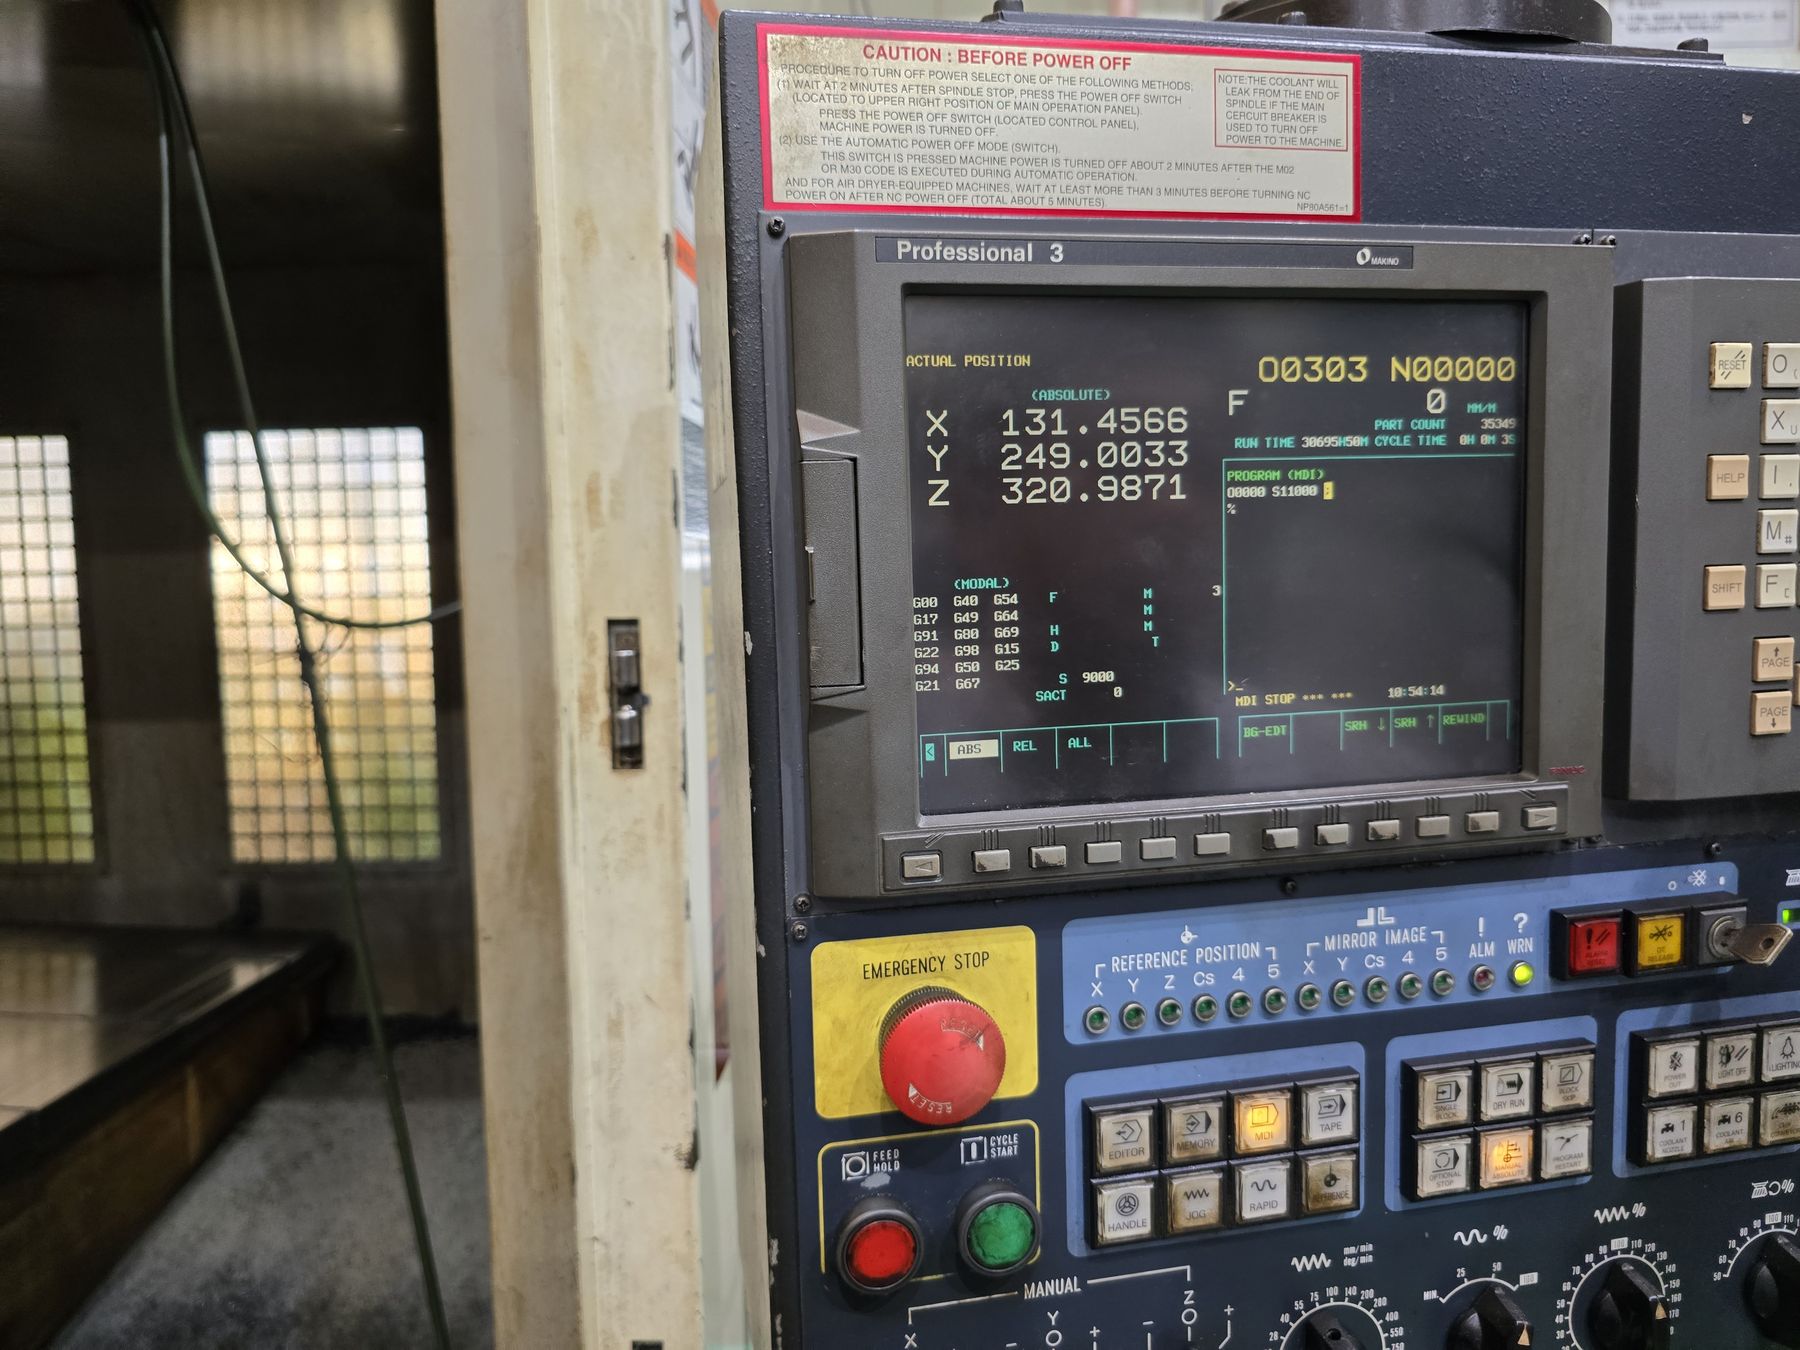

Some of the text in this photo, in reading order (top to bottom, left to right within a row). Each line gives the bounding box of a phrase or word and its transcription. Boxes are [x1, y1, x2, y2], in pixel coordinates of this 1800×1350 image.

[863, 45, 941, 62] CAUTION
[958, 50, 1027, 66] BEFORE
[1033, 52, 1094, 69] POWER
[1100, 57, 1131, 70] OFF
[1269, 77, 1314, 88] COOLANT
[1317, 79, 1338, 89] WILL
[1226, 87, 1340, 100] LEAK FROM THE END OF
[1226, 99, 1324, 111] SPINDLE IF THE MAIN
[1226, 111, 1327, 123] CERCUIT BREAKER IS
[820, 122, 998, 136] MACHINE POWER IS TURNED OFF.
[1226, 123, 1318, 135] USED TO TURN OFF
[1226, 135, 1261, 145] POWER
[1264, 136, 1276, 145] TO
[1279, 136, 1297, 146] THE
[786, 190, 826, 201] POWER
[830, 191, 846, 201] ON
[849, 191, 884, 202] AFTER
[887, 192, 902, 203] NC
[906, 193, 944, 204] POWER
[947, 194, 968, 204] OFF
[971, 194, 1008, 206] (TOTAL
[1010, 195, 1045, 206] ABOUT
[1049, 196, 1053, 206] 5
[897, 241, 1064, 263] Professional 3
[1371, 256, 1399, 266] MAKINO
[906, 354, 1031, 367] ACTUAL POSITION
[1719, 359, 1746, 371] RESET
[1390, 356, 1516, 382] N00000
[1032, 389, 1110, 401] (ABSOLUTE)
[1228, 389, 1497, 416] F 0 MM/M
[926, 408, 1189, 437] X 131.4566
[1374, 418, 1516, 431] PART COUNT 35349
[1234, 438, 1258, 449] RUN
[1265, 437, 1295, 448] TIME
[1374, 435, 1411, 447] CYCLE
[1418, 435, 1447, 446] TIME
[927, 441, 1189, 470] Y 249.0033
[1227, 469, 1325, 482] PROGRAM (MDI)
[1717, 473, 1745, 484] HELP
[927, 475, 1187, 506] Z 320.9871
[1272, 486, 1317, 497] S11000
[1766, 521, 1781, 540] M
[955, 577, 1009, 590] (MODAL)
[1712, 583, 1742, 594] SHIFT
[913, 592, 1058, 609] G00 G40 G54 F
[913, 610, 1019, 625] G17 G49 G64
[914, 625, 1059, 642] G91 G80 G69 H
[914, 642, 1059, 659] G22 G98 G15 D
[915, 660, 1020, 675] G94 G50 G25
[1762, 657, 1790, 668] PAGE
[1059, 671, 1115, 684] S 9000
[915, 678, 980, 692] G21 G67
[1036, 686, 1122, 702] SACT 0
[1235, 684, 1445, 707] MDI STOP 10:54:14
[1760, 707, 1788, 717] PAGE
[1243, 712, 1486, 738] BG-EDT SRH SRH REWIND
[957, 737, 1092, 755] ABS REL ALL
[1324, 926, 1427, 952] MIRROR IMAGE
[1469, 942, 1495, 958] ALM
[1507, 938, 1534, 955] WRN
[1112, 942, 1260, 973] REFERENCE POSITION
[863, 951, 990, 980] EMERGENCY STOP
[912, 1093, 952, 1114] RESET
[1493, 1099, 1525, 1110] DRY RUN
[1320, 1122, 1342, 1132] TAPE
[990, 1133, 1019, 1146] CYCLE
[1254, 1131, 1274, 1141] MDI
[991, 1145, 1019, 1157] START
[1176, 1138, 1216, 1151] MEMORY
[873, 1149, 900, 1161] FEED
[1108, 1146, 1145, 1160] EDITOR
[873, 1161, 900, 1172] HOLD
[1429, 1171, 1461, 1182] OPTIONAL
[1436, 1179, 1454, 1188] STOP
[1250, 1200, 1278, 1212] RAPID
[1185, 1209, 1206, 1220] JOG
[1108, 1218, 1147, 1232] HANDLE
[1344, 1243, 1373, 1255] mm/min
[1344, 1254, 1373, 1267] deg/min
[1023, 1276, 1081, 1299] MANUAL
[1326, 1286, 1399, 1322] 100 140 200 400
